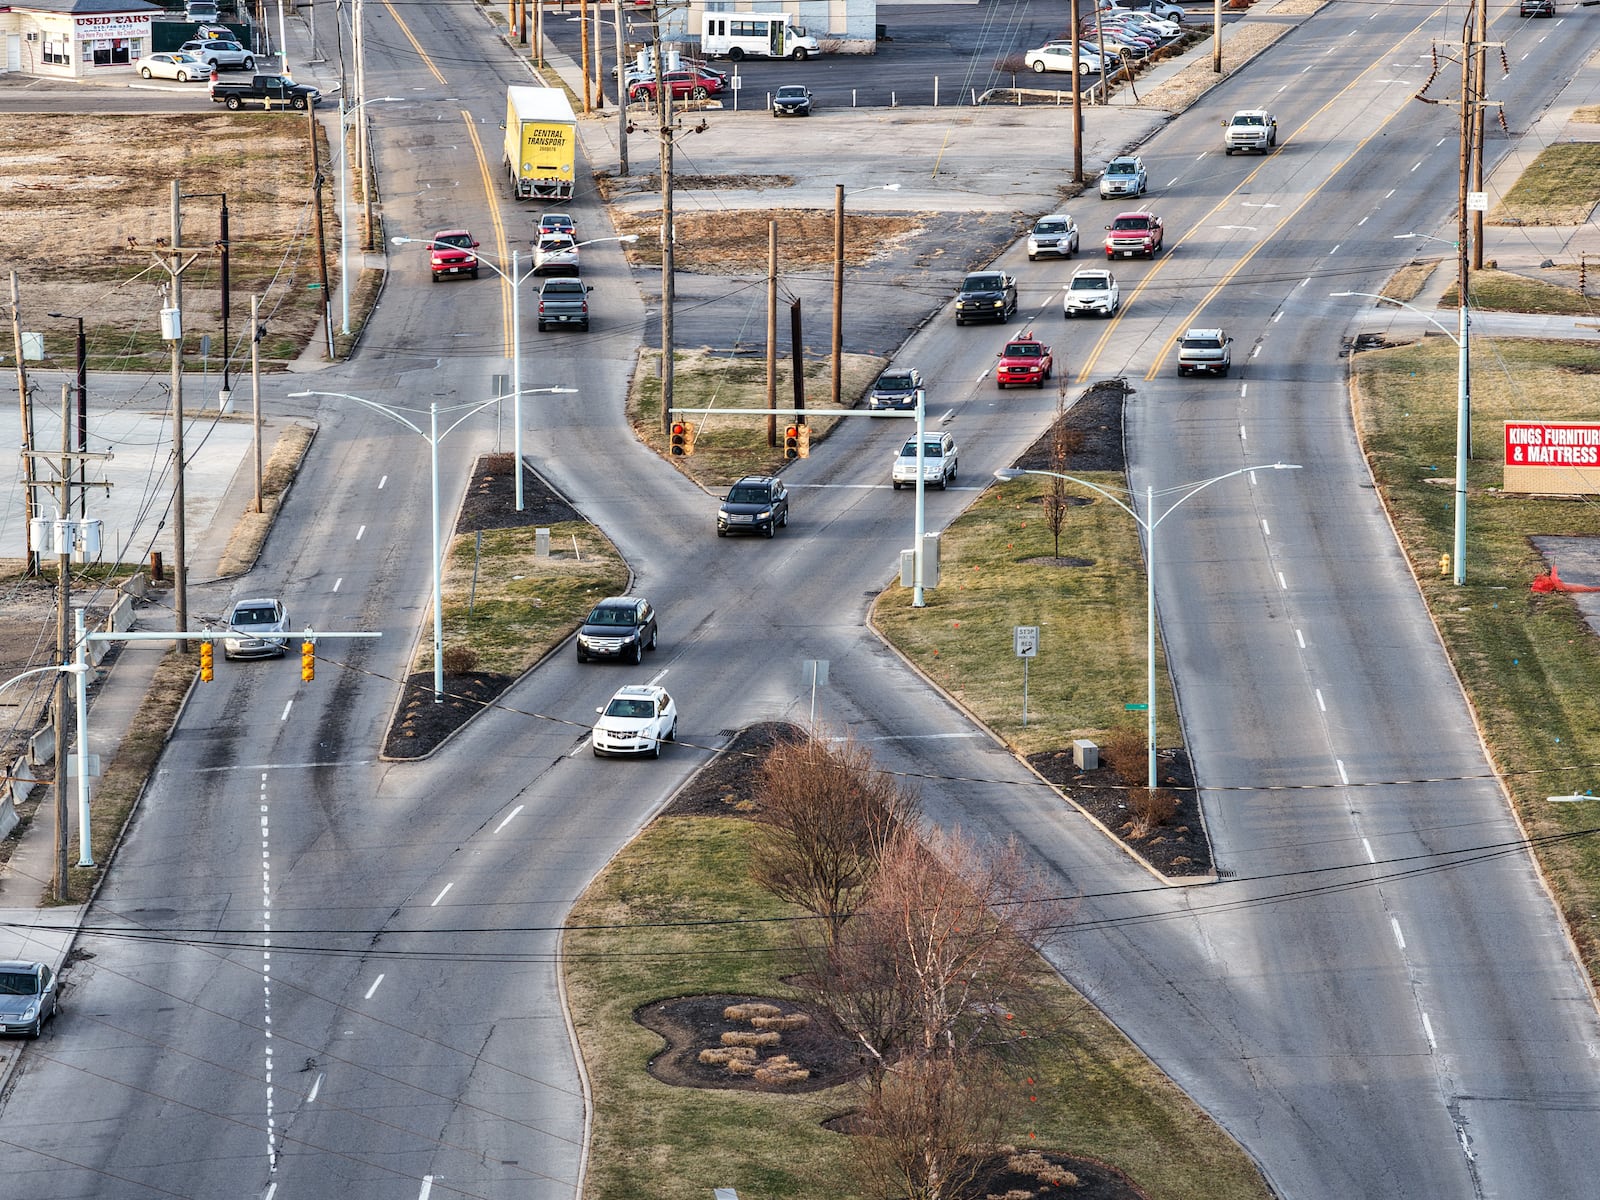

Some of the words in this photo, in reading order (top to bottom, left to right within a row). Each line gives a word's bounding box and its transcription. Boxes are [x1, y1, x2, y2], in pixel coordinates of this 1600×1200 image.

[77, 17, 111, 25] USED
[116, 15, 149, 24] CARS
[533, 129, 563, 138] CENTRAL
[528, 137, 566, 146] TRANSPORT
[1509, 428, 1542, 445] KINGS
[1544, 428, 1600, 446] FURNITUR
[1513, 446, 1523, 462] &
[1527, 446, 1598, 463] MATTRESS
